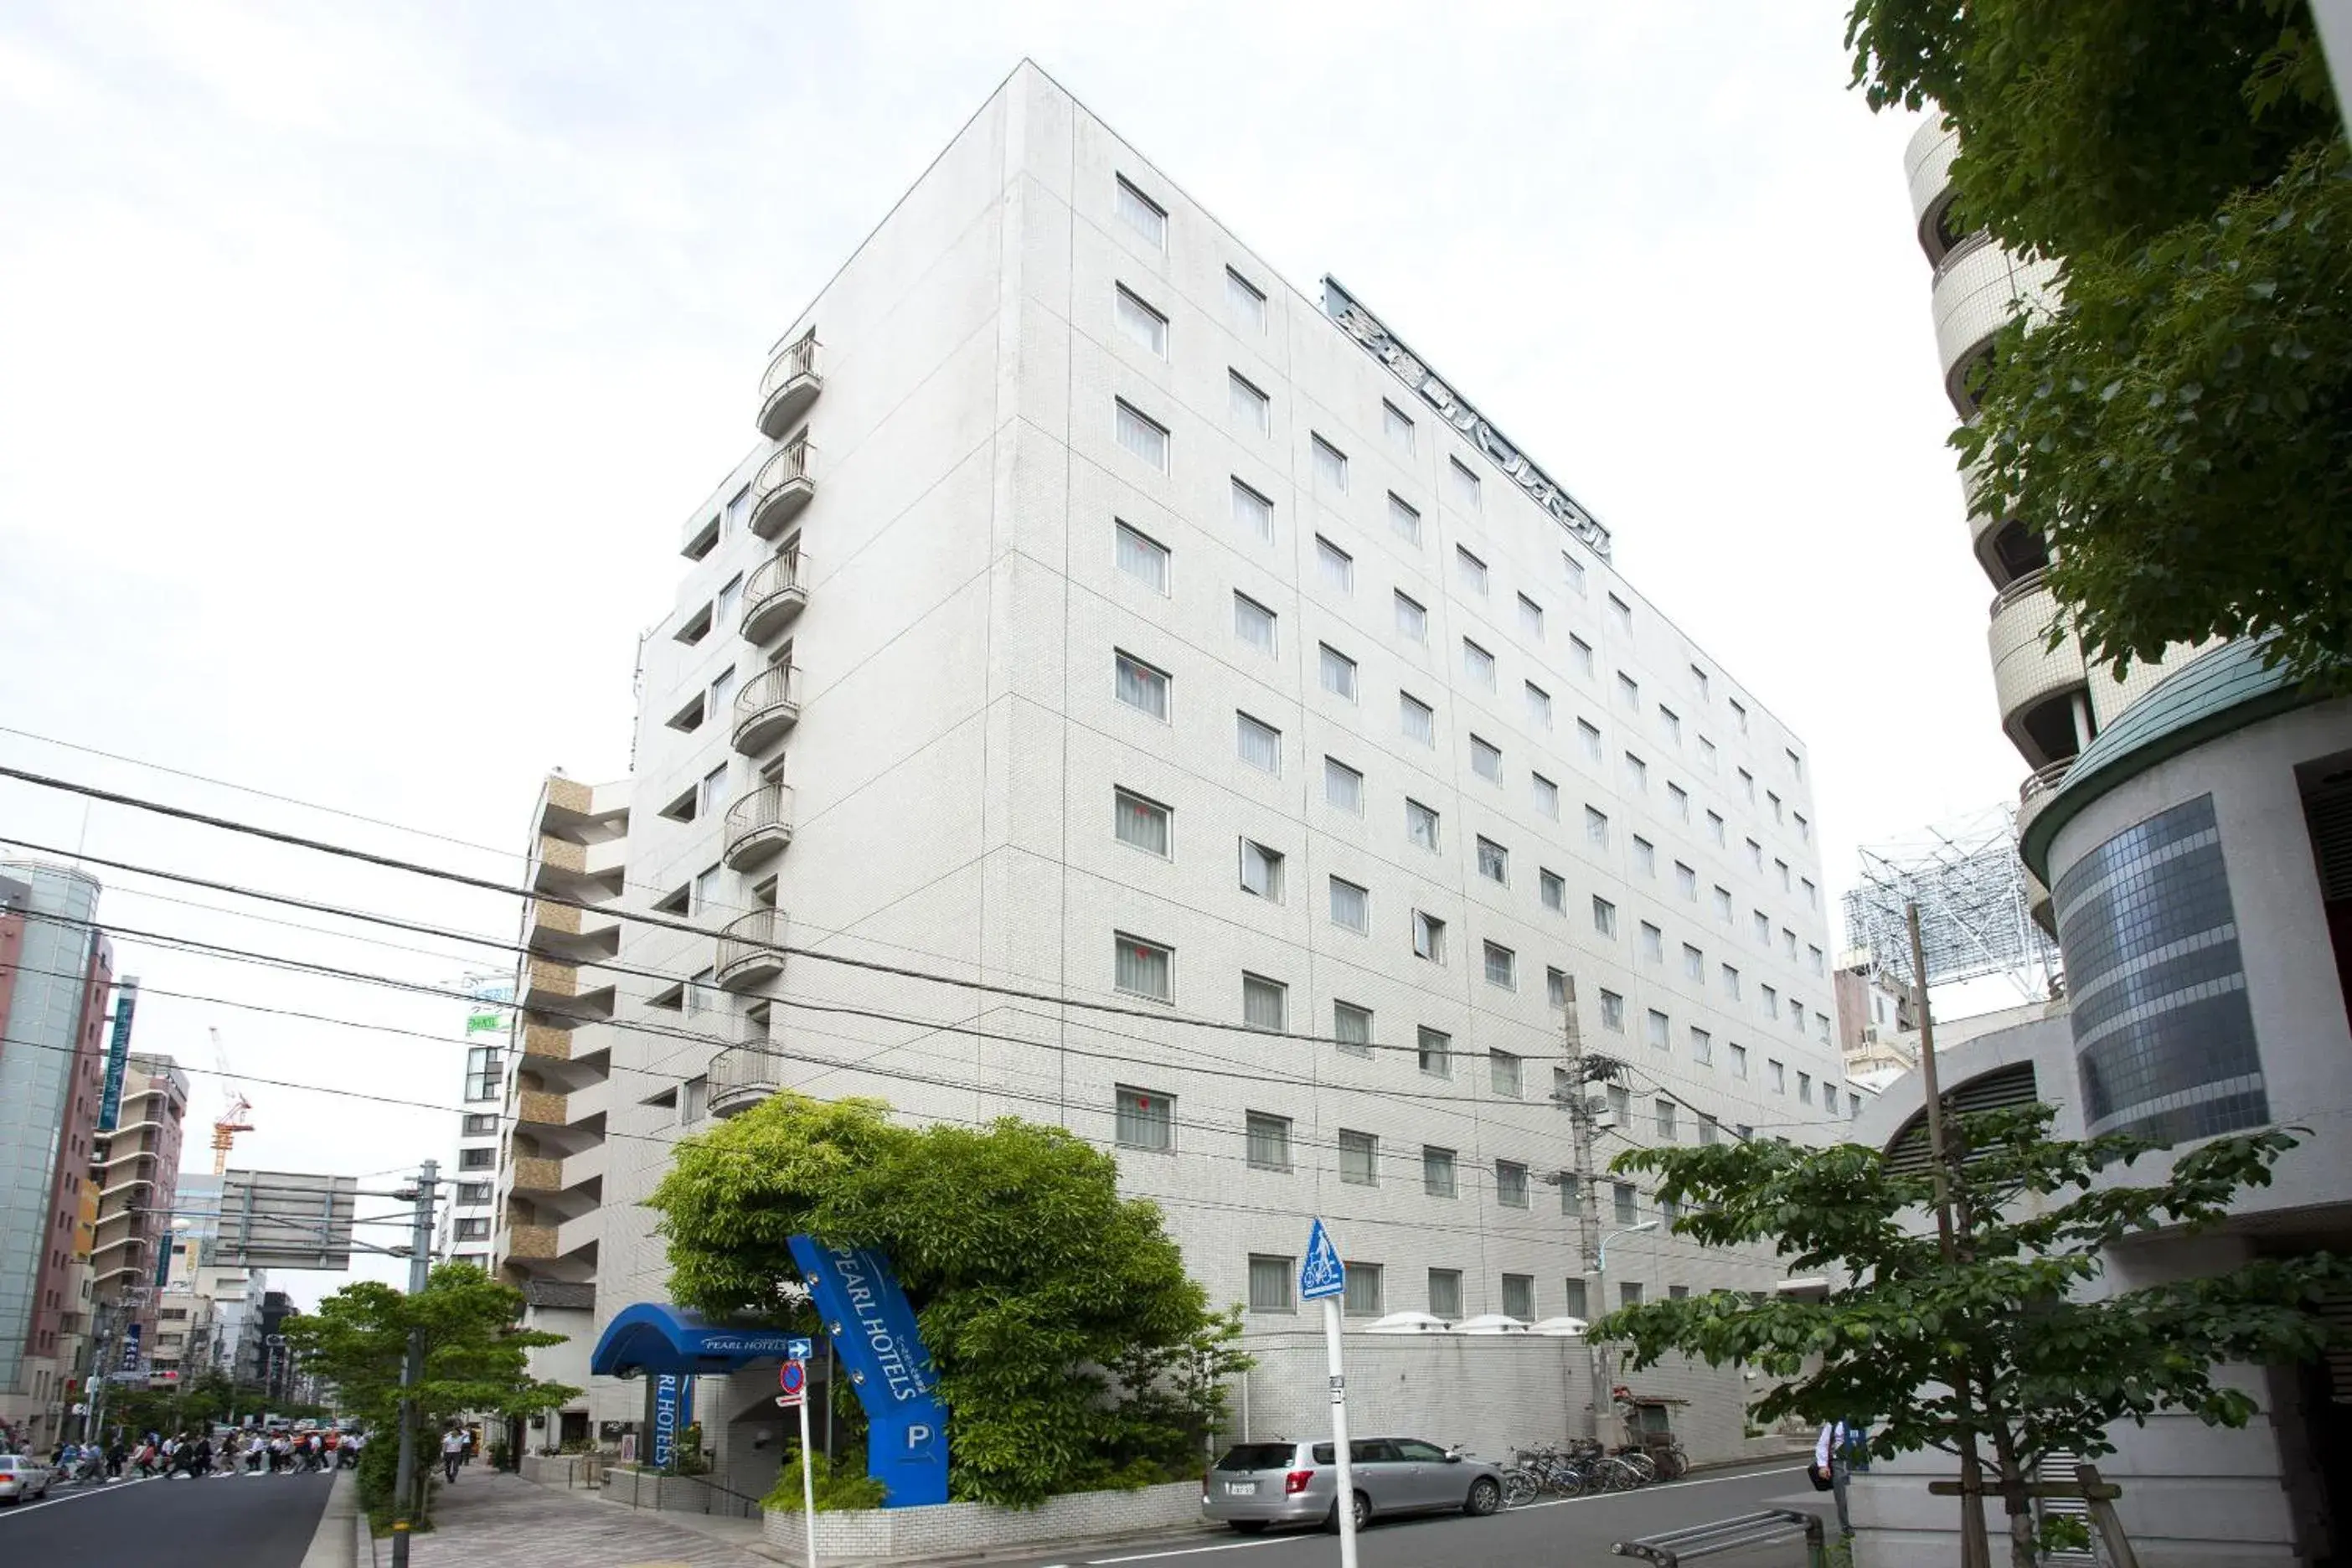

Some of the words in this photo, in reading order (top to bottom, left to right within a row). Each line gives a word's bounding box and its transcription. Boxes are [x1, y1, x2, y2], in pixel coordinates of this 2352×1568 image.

[706, 1341, 740, 1349] PEARL
[744, 1341, 787, 1350] HOTELS
[831, 1246, 876, 1317] PEARL
[862, 1318, 916, 1401] HOTELS
[655, 1398, 674, 1464] HOTELS
[909, 1425, 929, 1449] P
